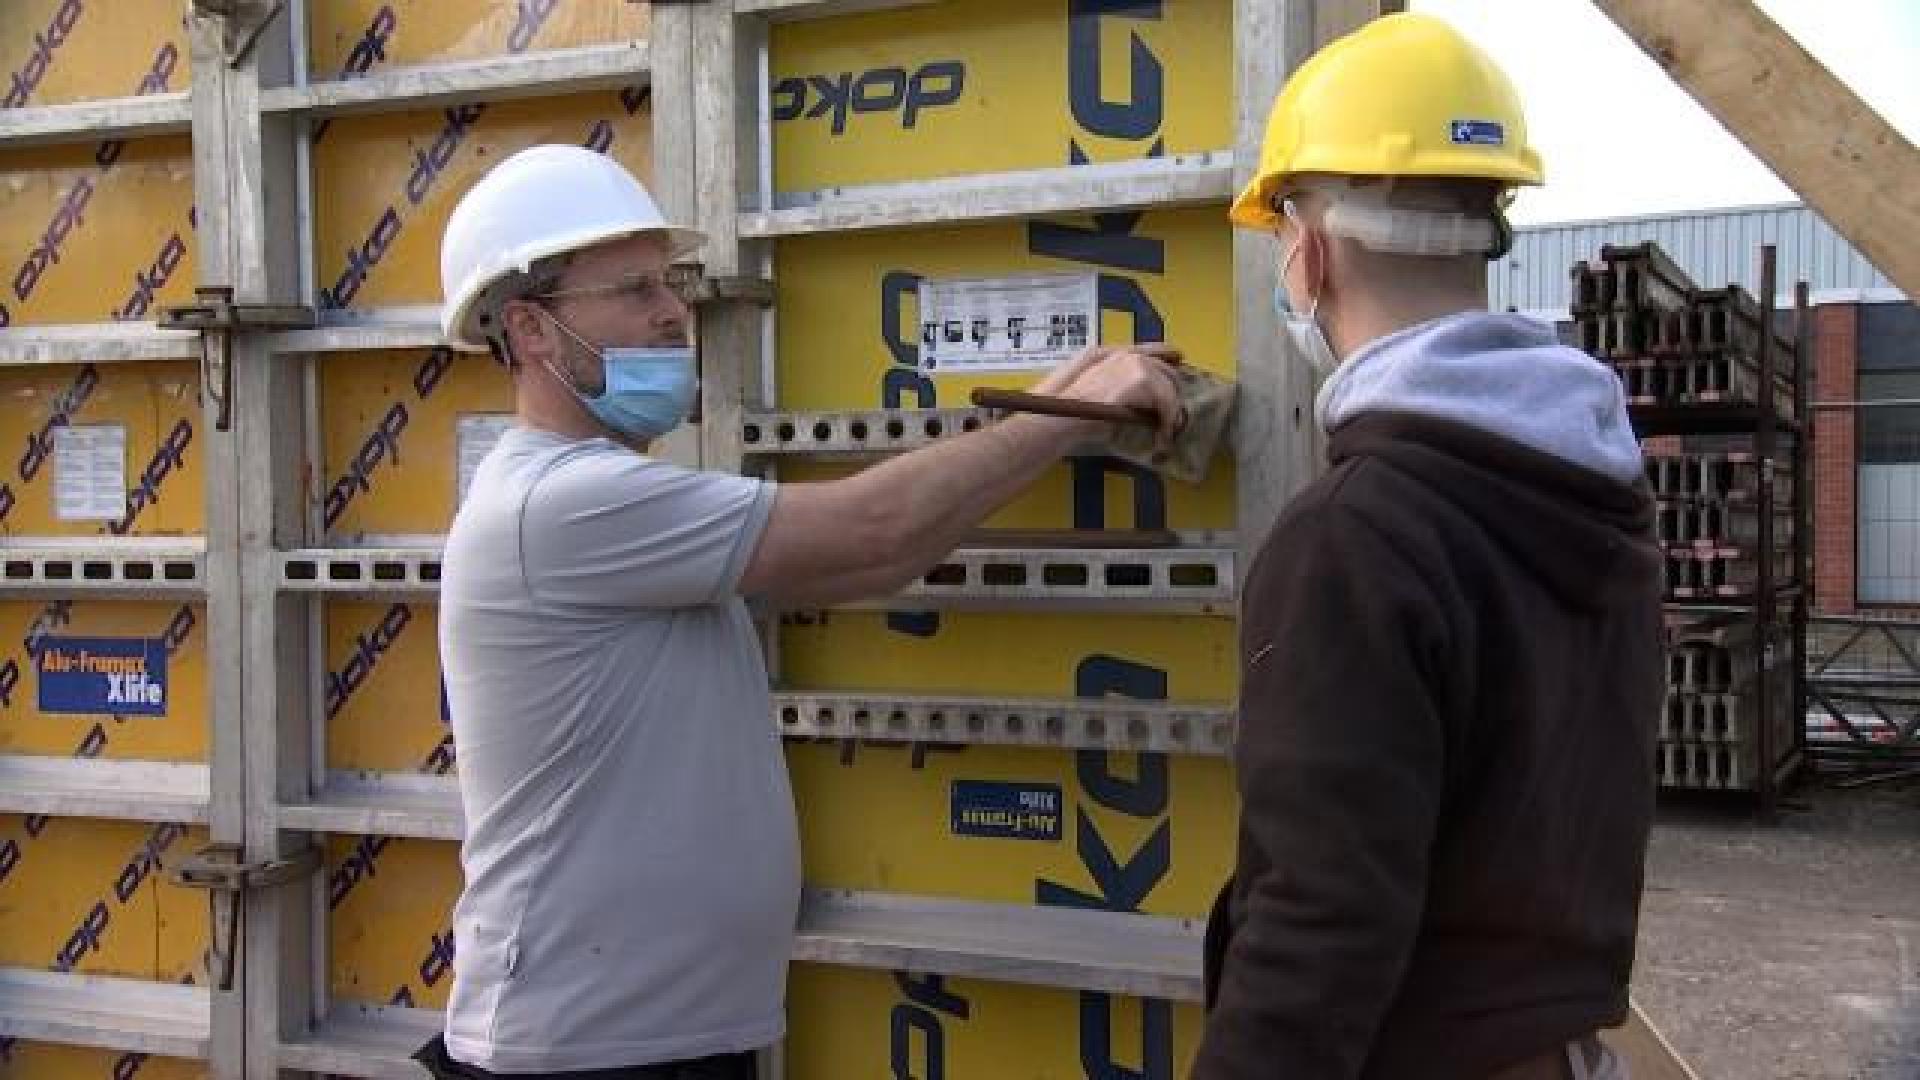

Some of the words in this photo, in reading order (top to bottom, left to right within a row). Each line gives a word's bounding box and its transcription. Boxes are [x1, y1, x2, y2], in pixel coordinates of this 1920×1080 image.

[14, 176, 94, 301] doka
[111, 234, 187, 322] oka
[114, 821, 189, 903] oka
